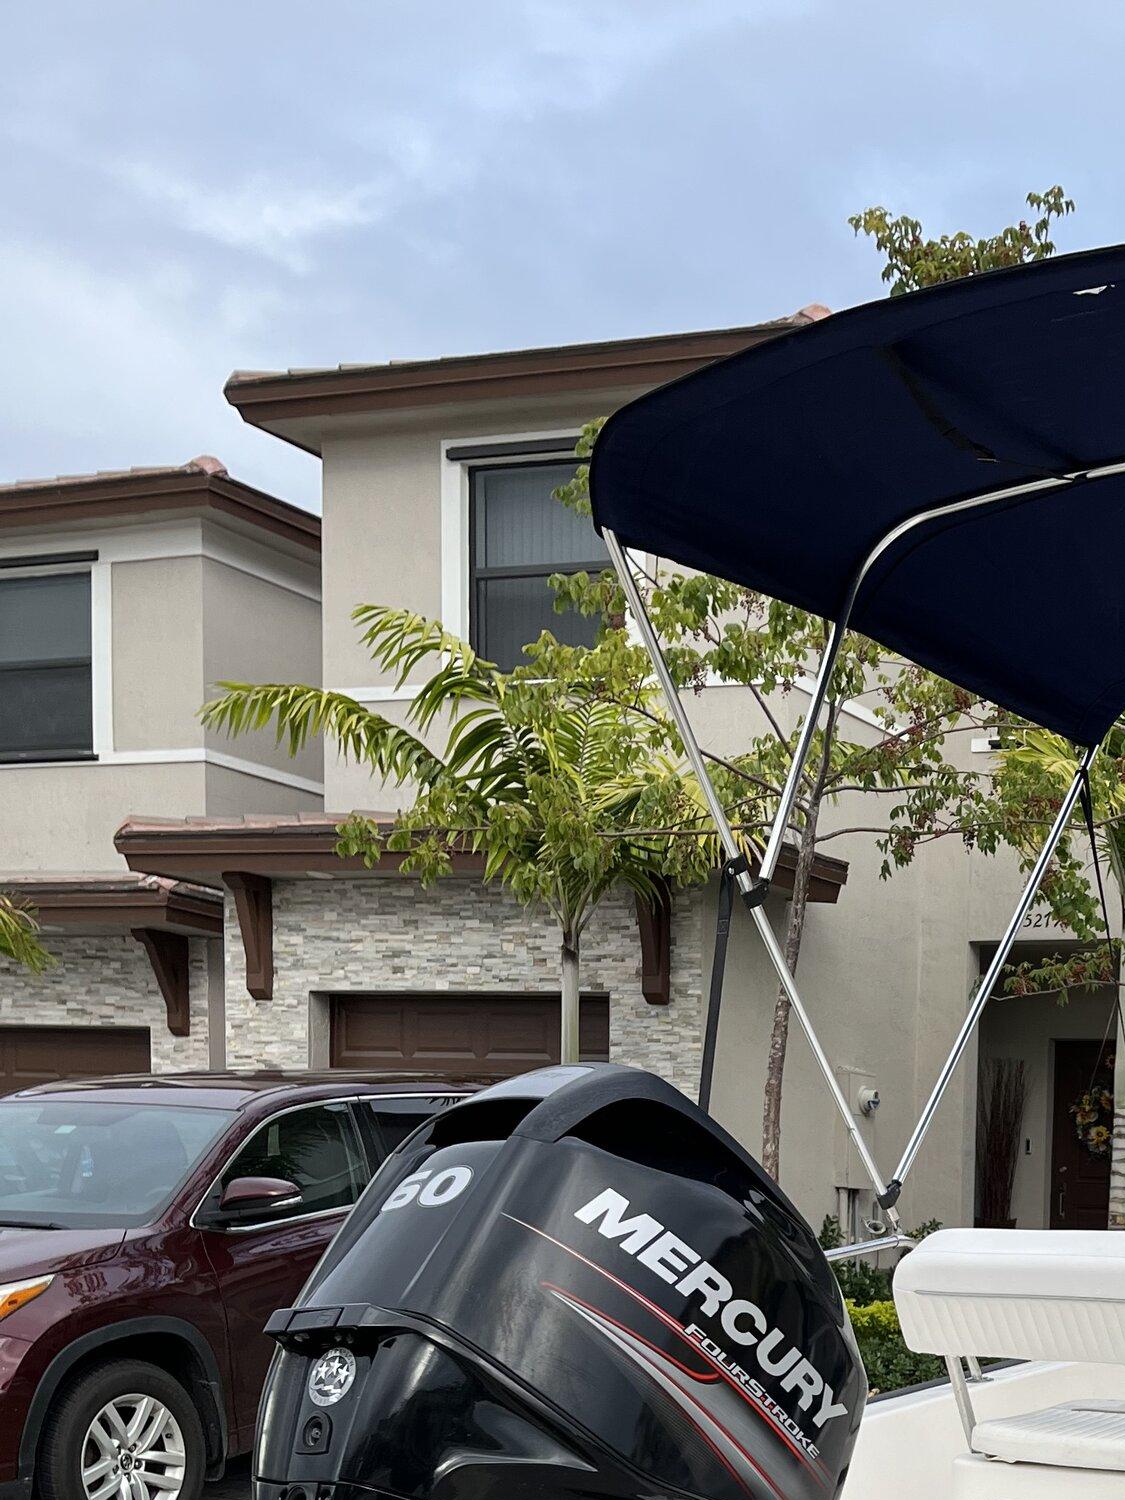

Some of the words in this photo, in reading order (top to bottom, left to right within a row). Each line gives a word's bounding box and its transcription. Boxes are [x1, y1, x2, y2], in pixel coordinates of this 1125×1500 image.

[380, 1166, 474, 1208] 60
[573, 1187, 849, 1429] MERCURY
[683, 1323, 820, 1459] FOURSTROKE
